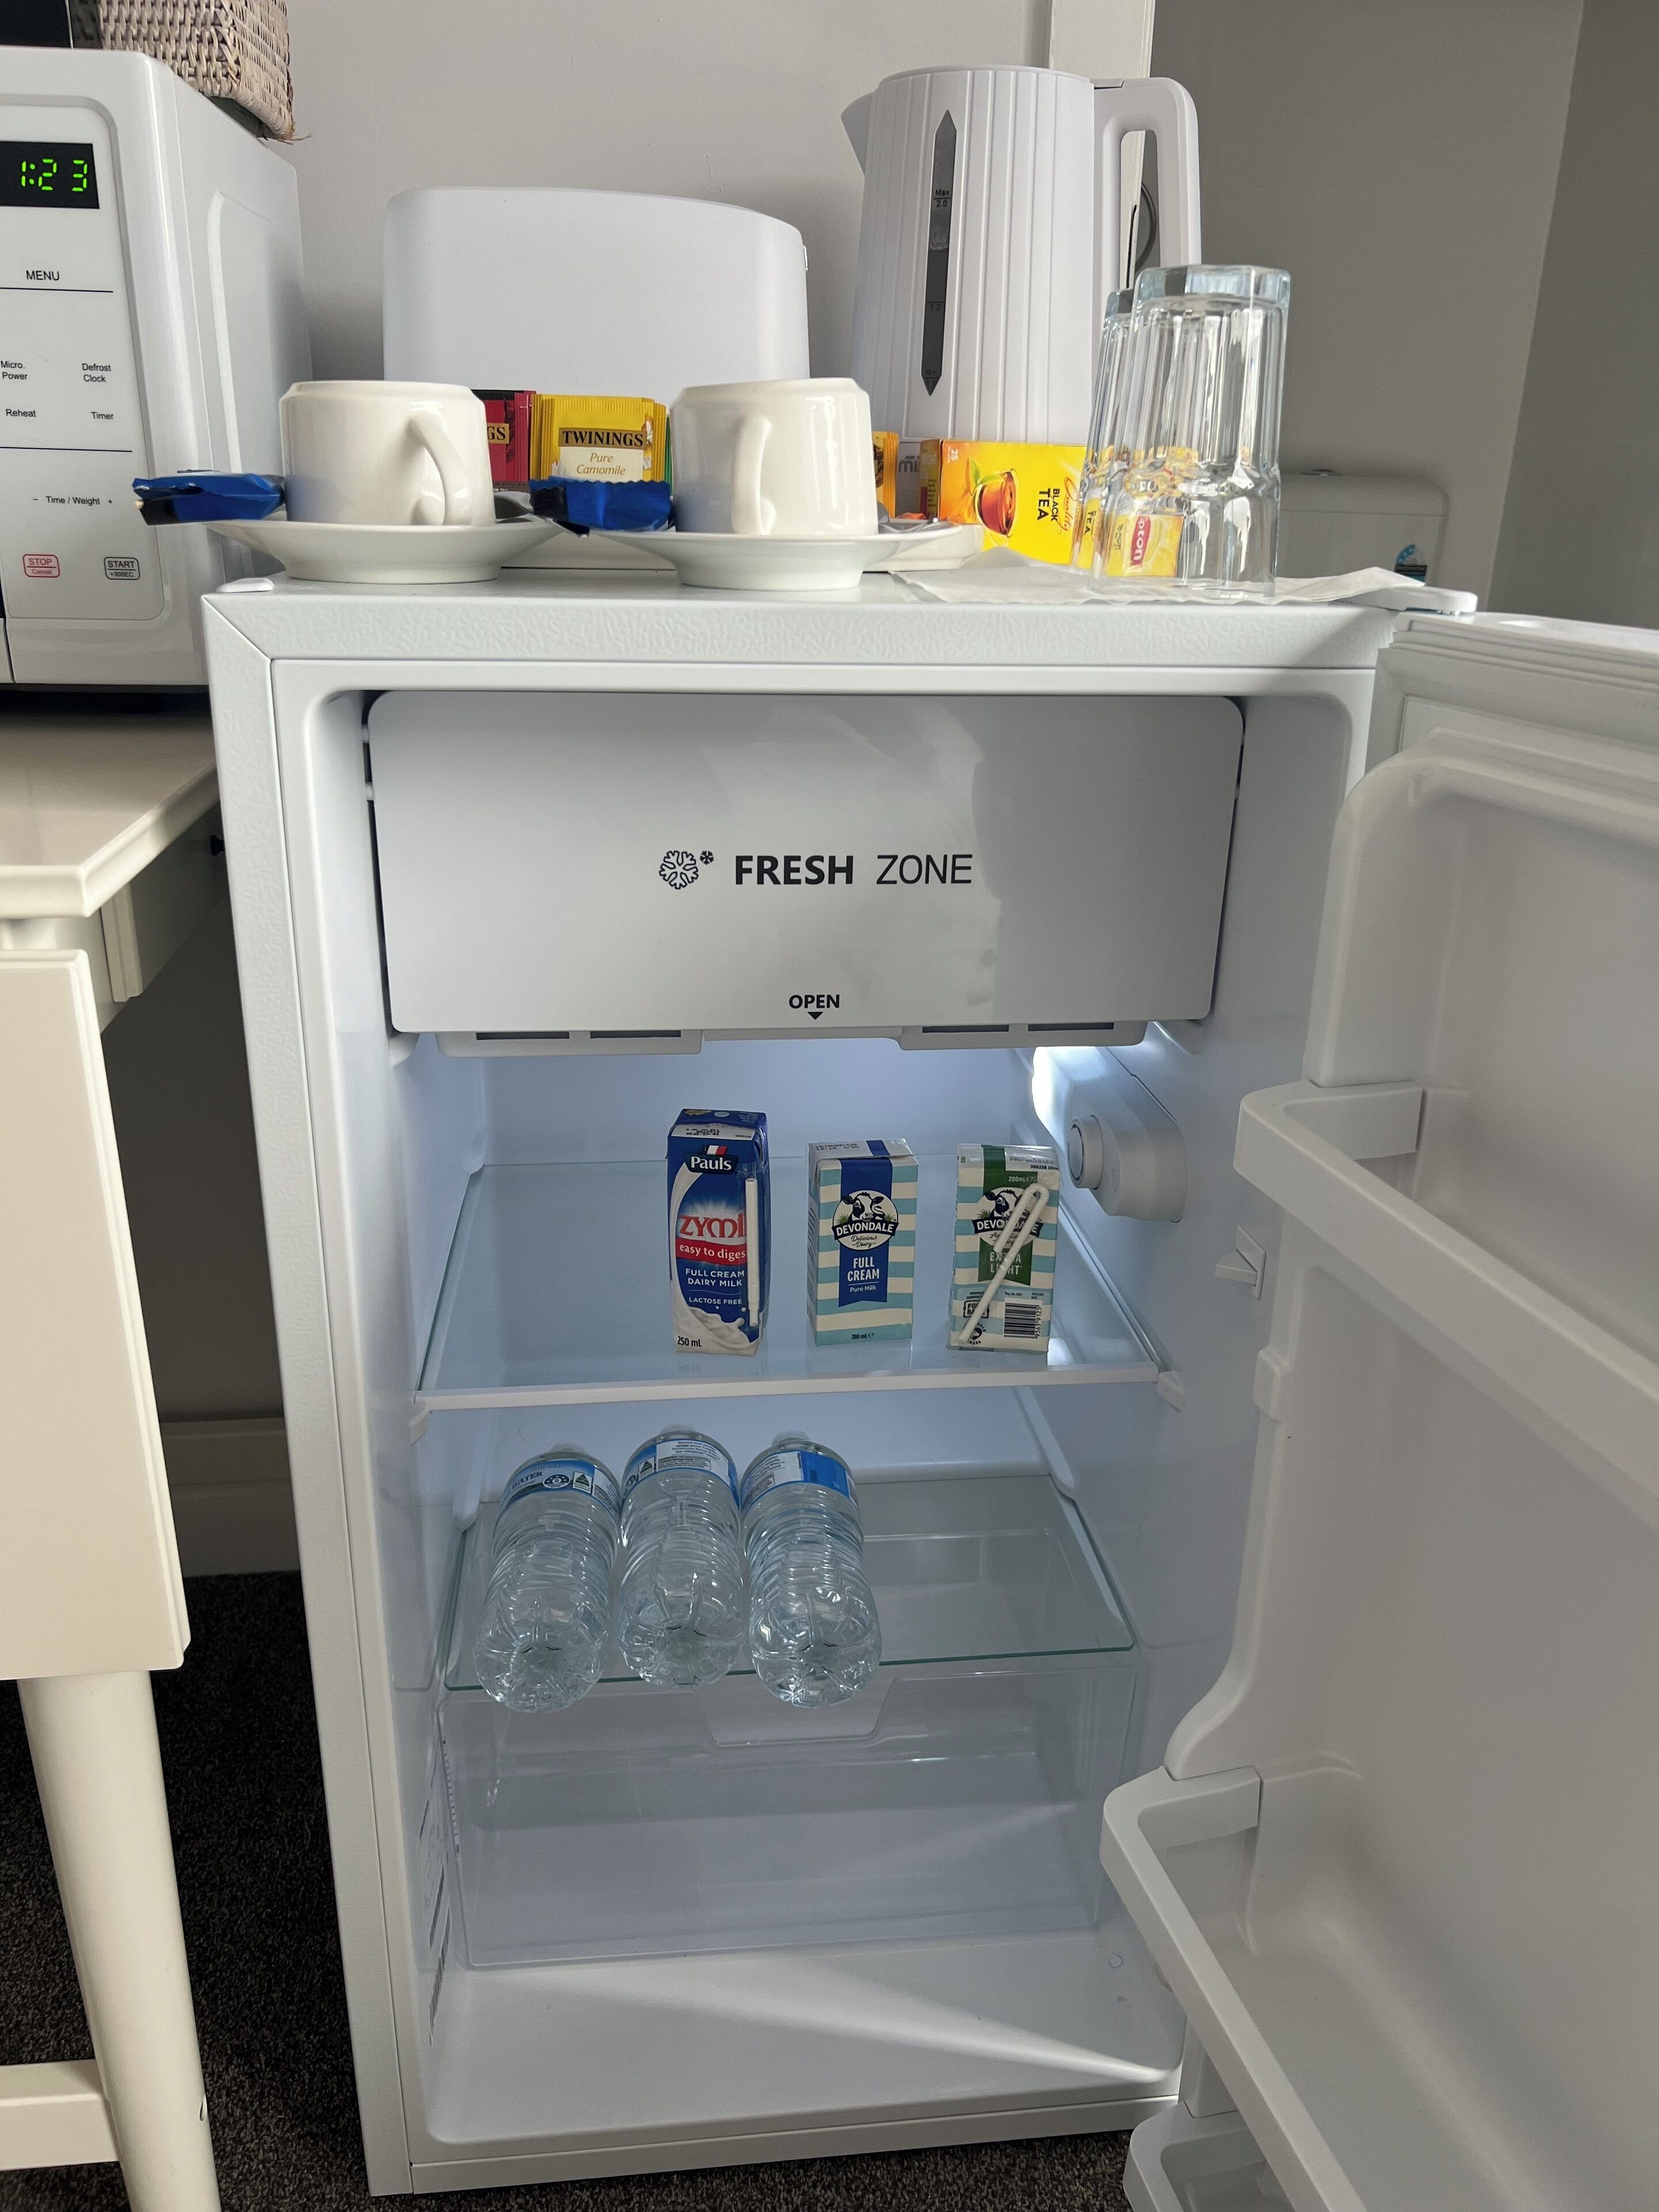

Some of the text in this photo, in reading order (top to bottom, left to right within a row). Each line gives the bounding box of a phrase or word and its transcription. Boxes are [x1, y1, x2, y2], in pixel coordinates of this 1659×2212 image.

[25, 270, 60, 282] MENU
[82, 363, 111, 372] Defrost
[2, 372, 28, 380] Power
[84, 374, 107, 382] Clock
[5, 408, 37, 418] Reheat
[91, 411, 114, 420] Timer
[562, 430, 644, 447] TWININGS
[589, 452, 613, 463] Pure
[950, 449, 959, 461] 25
[576, 464, 626, 475] Camomile
[72, 497, 101, 506] Weight
[1037, 488, 1051, 521] TEA
[1051, 488, 1060, 522] BLACK
[29, 558, 52, 566] STOP
[108, 560, 135, 569] START
[735, 854, 973, 885] FRESH ZONE
[789, 994, 840, 1009] OPEN
[691, 1156, 732, 1171] Pauls
[836, 1222, 895, 1237] DEVONDALE
[679, 1244, 746, 1262] easy to diges
[853, 1256, 875, 1268] FULL
[685, 1268, 745, 1278] FULL CREAM
[847, 1268, 880, 1282] CREAM
[991, 1263, 1020, 1275] LIHT
[688, 1278, 716, 1286] DAIRY
[688, 1297, 722, 1305] LACTOSE
[677, 1335, 702, 1347] 250 mL
